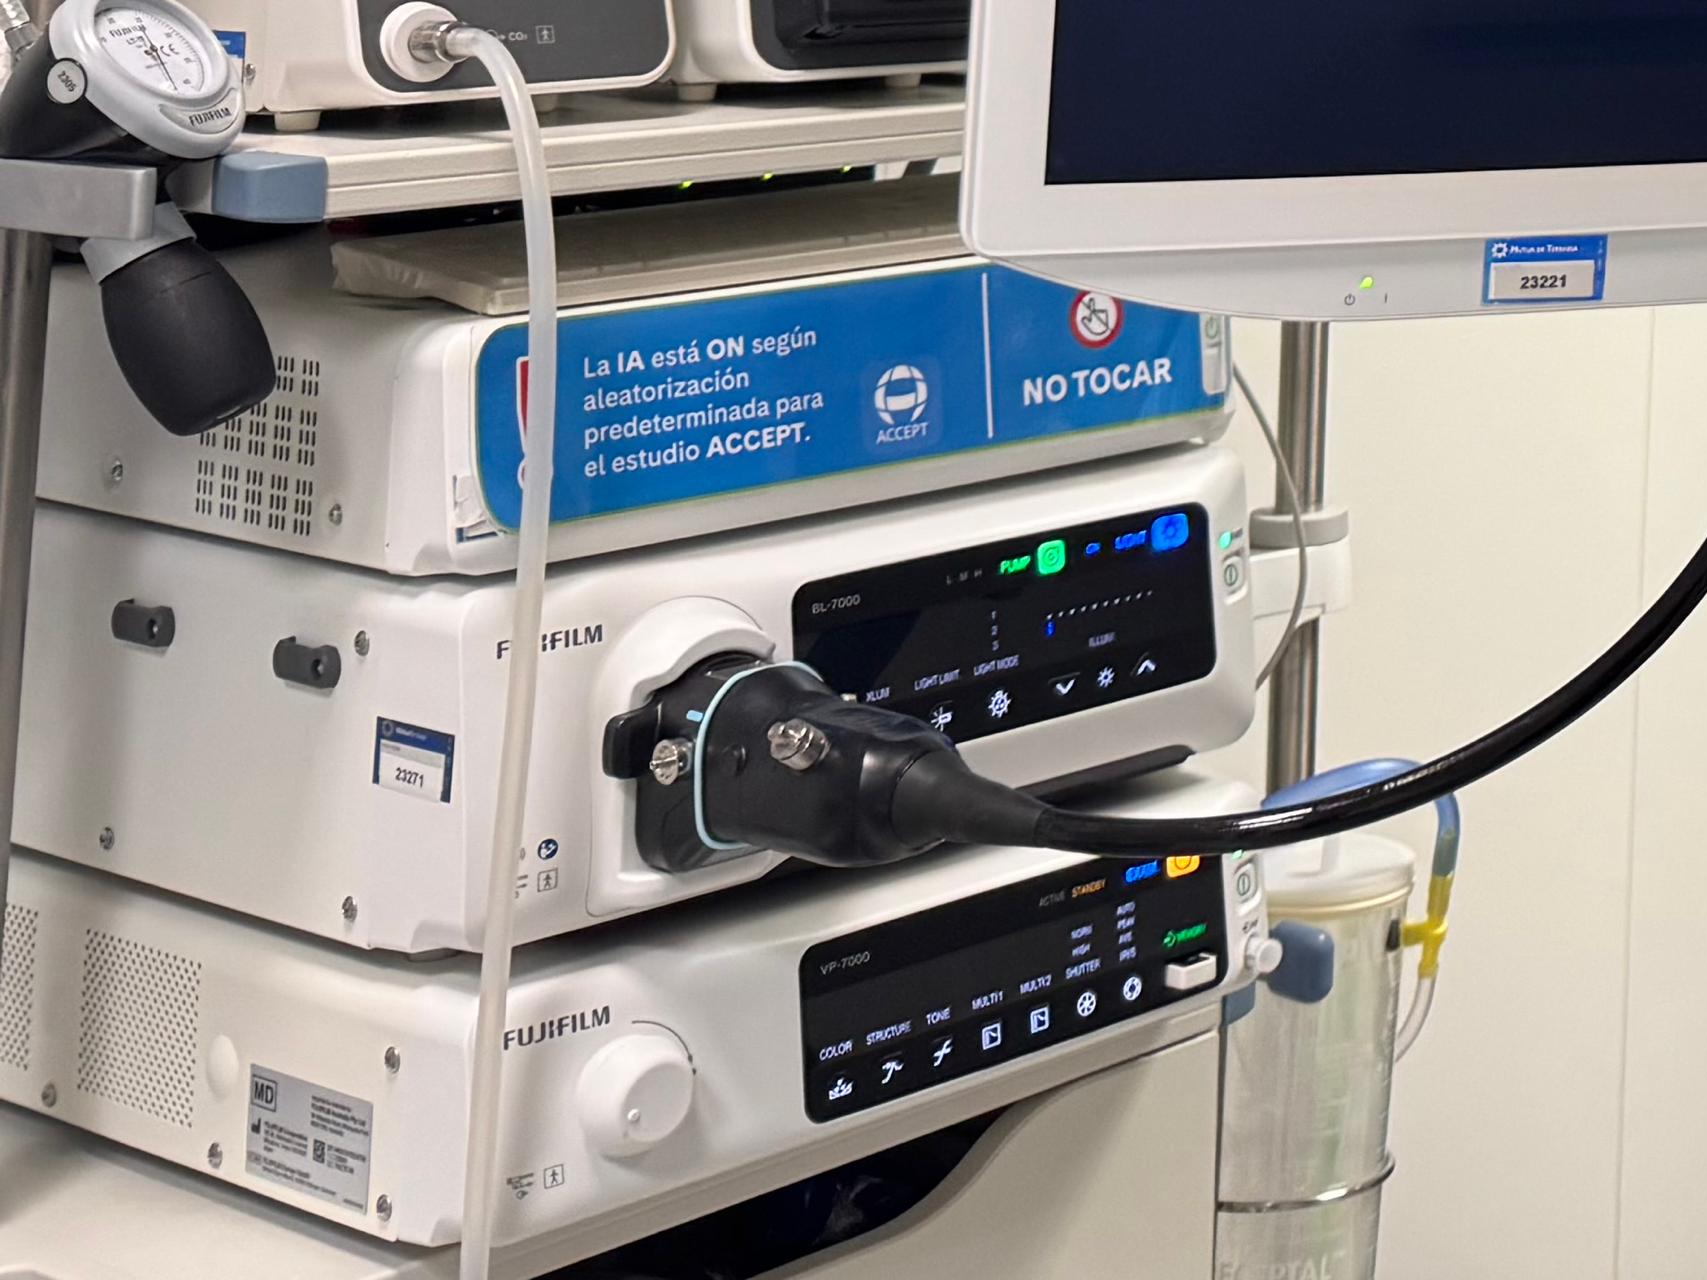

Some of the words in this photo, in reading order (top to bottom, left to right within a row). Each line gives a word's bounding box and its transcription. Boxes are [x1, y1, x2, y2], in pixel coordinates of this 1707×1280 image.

[1520, 274, 1567, 290] 23221
[583, 357, 611, 379] La
[617, 350, 645, 374] IA
[651, 339, 701, 368] está
[706, 336, 744, 361] ON
[751, 326, 817, 356] según
[583, 366, 750, 412] aleatorización
[1022, 376, 1067, 407] NO
[1072, 357, 1173, 398] TOCAR
[584, 397, 770, 450] predeterminada
[776, 391, 824, 419] para
[876, 422, 930, 445] ACCEPT
[584, 454, 606, 478] el
[611, 441, 700, 473] estudio
[706, 422, 811, 458] ACCEPT.
[812, 594, 861, 615] BL-7000
[496, 623, 603, 660] FIFILM
[395, 766, 424, 788] 23271
[819, 951, 871, 976] VP-7000
[503, 1005, 611, 1052] FUJIFILM
[926, 1007, 951, 1026] TONE
[866, 1020, 912, 1046] STRUCTURE
[819, 1039, 853, 1062] COLOR
[254, 1080, 275, 1105] MD
